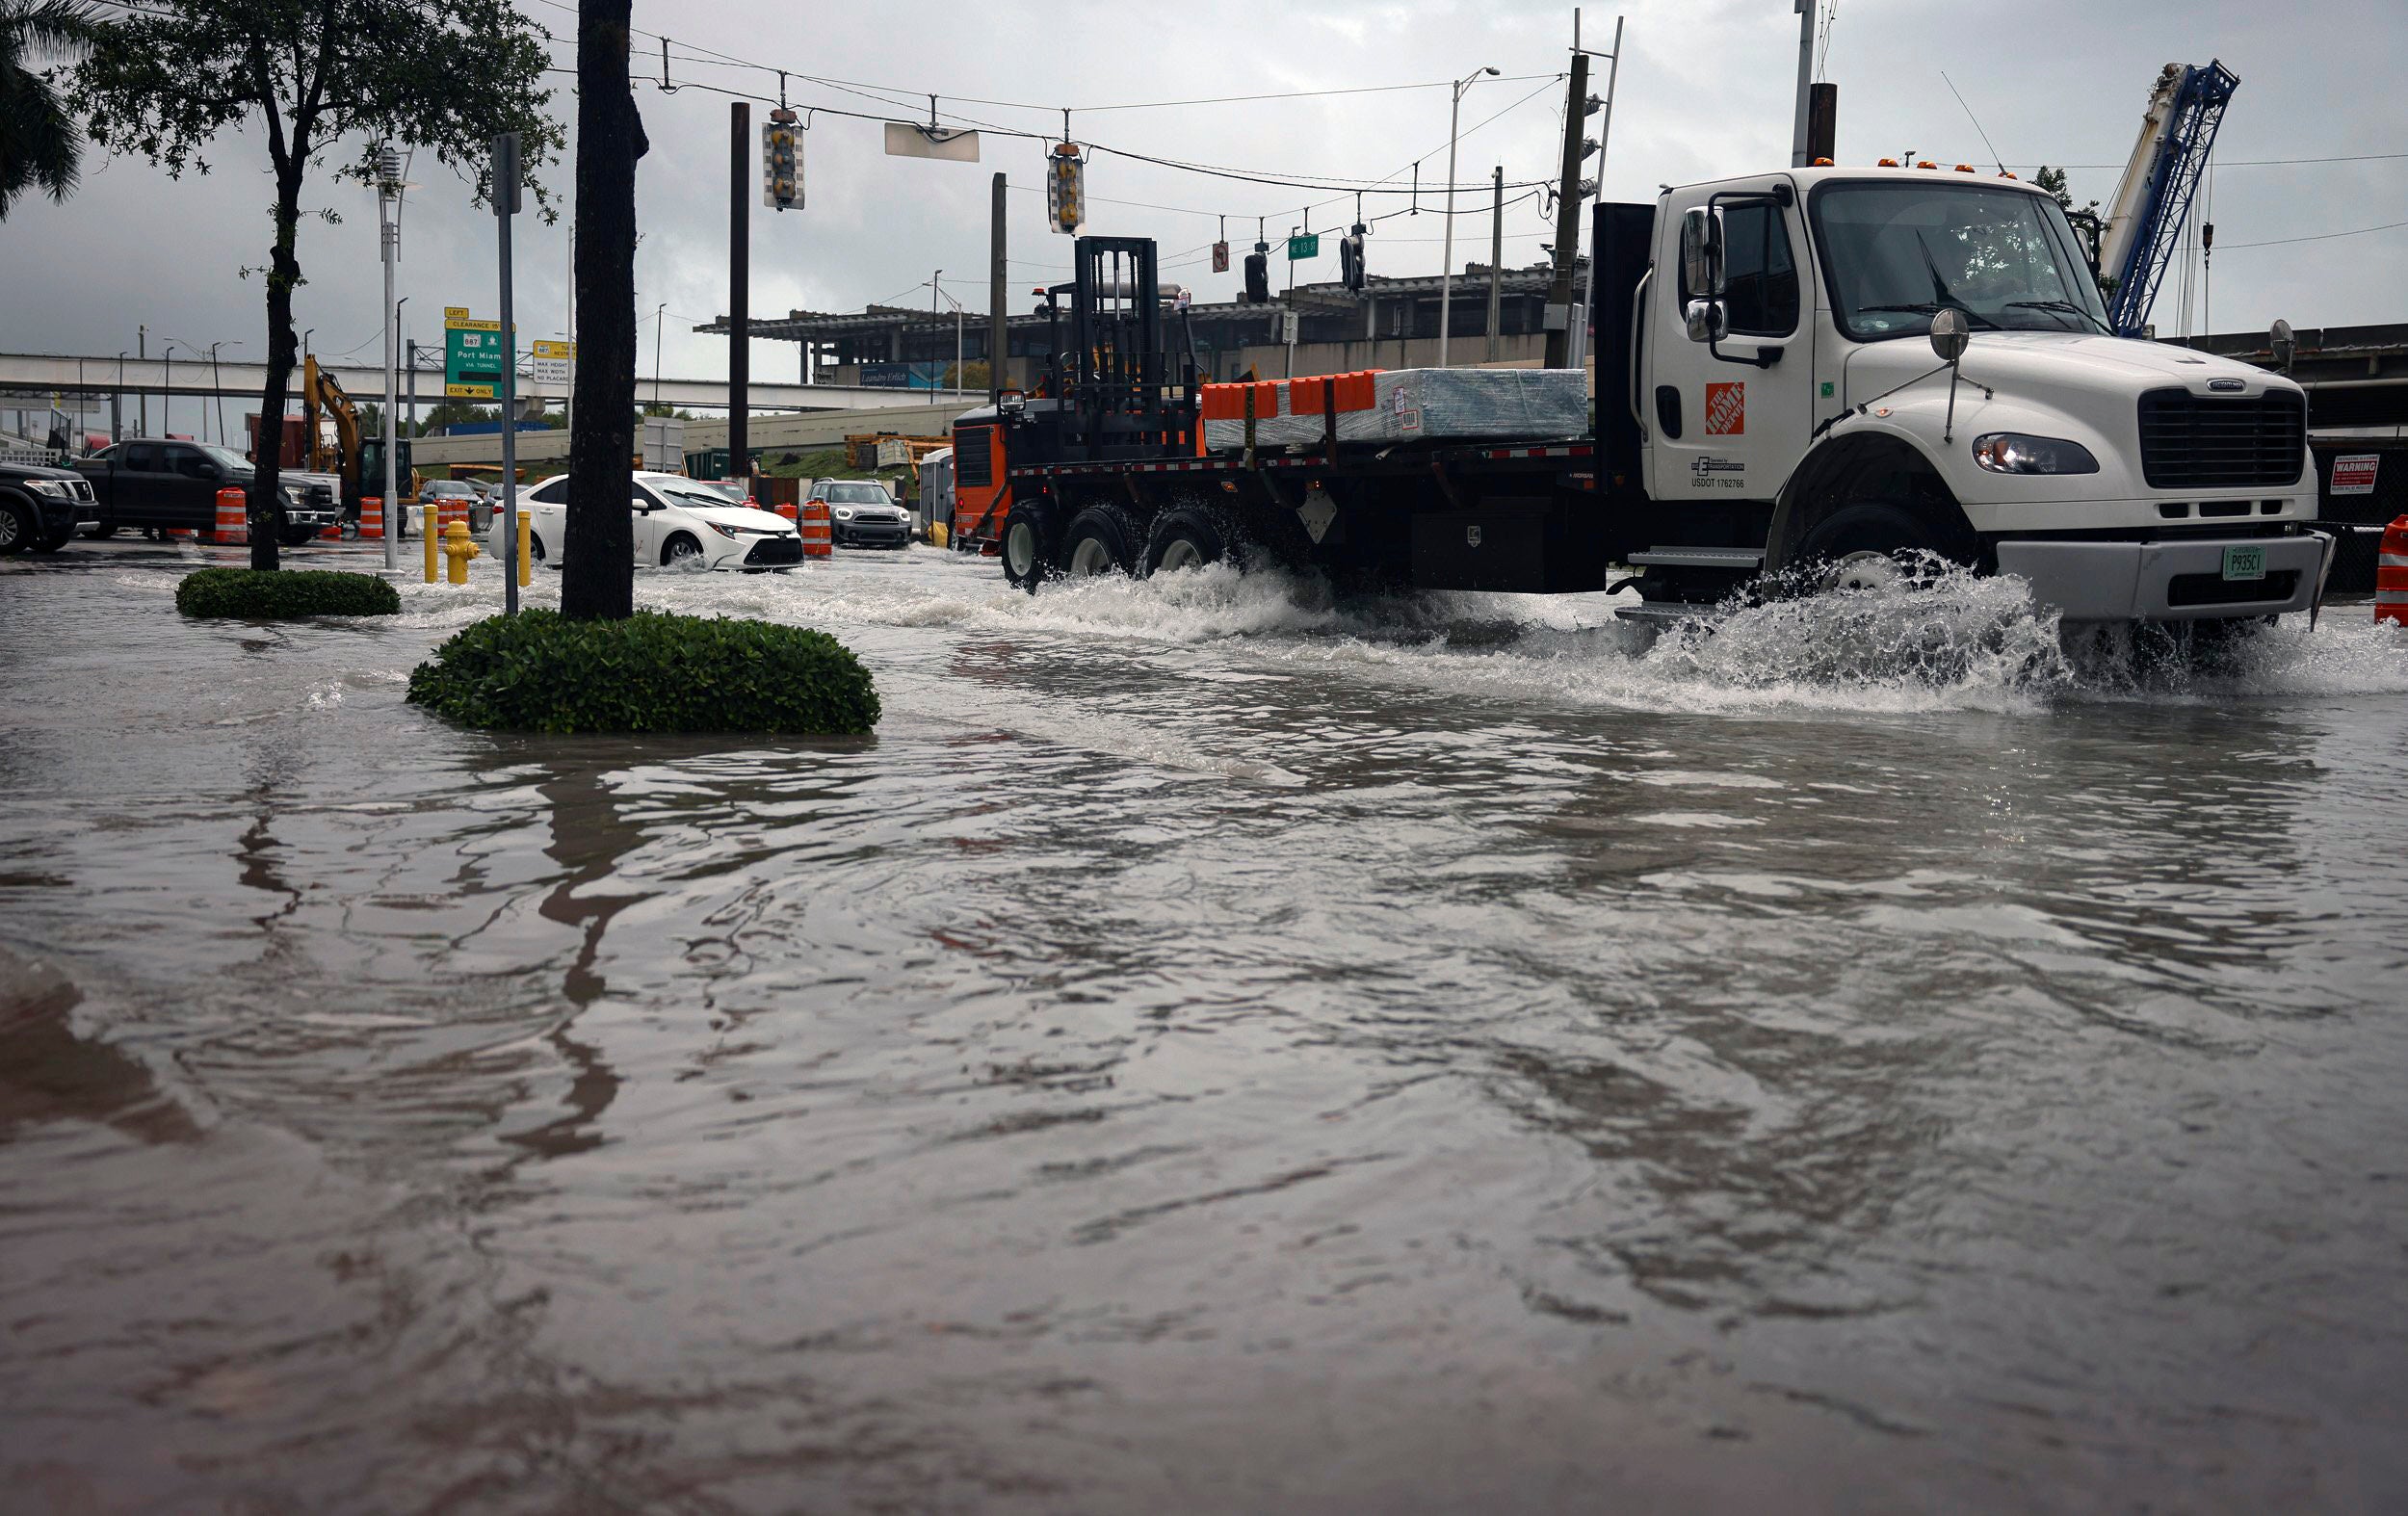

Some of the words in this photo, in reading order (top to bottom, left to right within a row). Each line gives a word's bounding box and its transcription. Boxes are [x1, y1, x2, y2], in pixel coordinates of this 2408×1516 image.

[2149, 148, 2160, 173] TADANO
[1300, 242, 1308, 253] 13
[1310, 241, 1316, 251] ST
[861, 373, 886, 382] Leandro
[887, 372, 906, 381] Erlich
[1710, 388, 1725, 409] THE
[1706, 382, 1744, 433] HOME
[1720, 402, 1744, 433] DEPOT
[2336, 462, 2375, 472] WARNING
[1691, 478, 1714, 487] USDOT
[1716, 479, 1744, 488] 1762766
